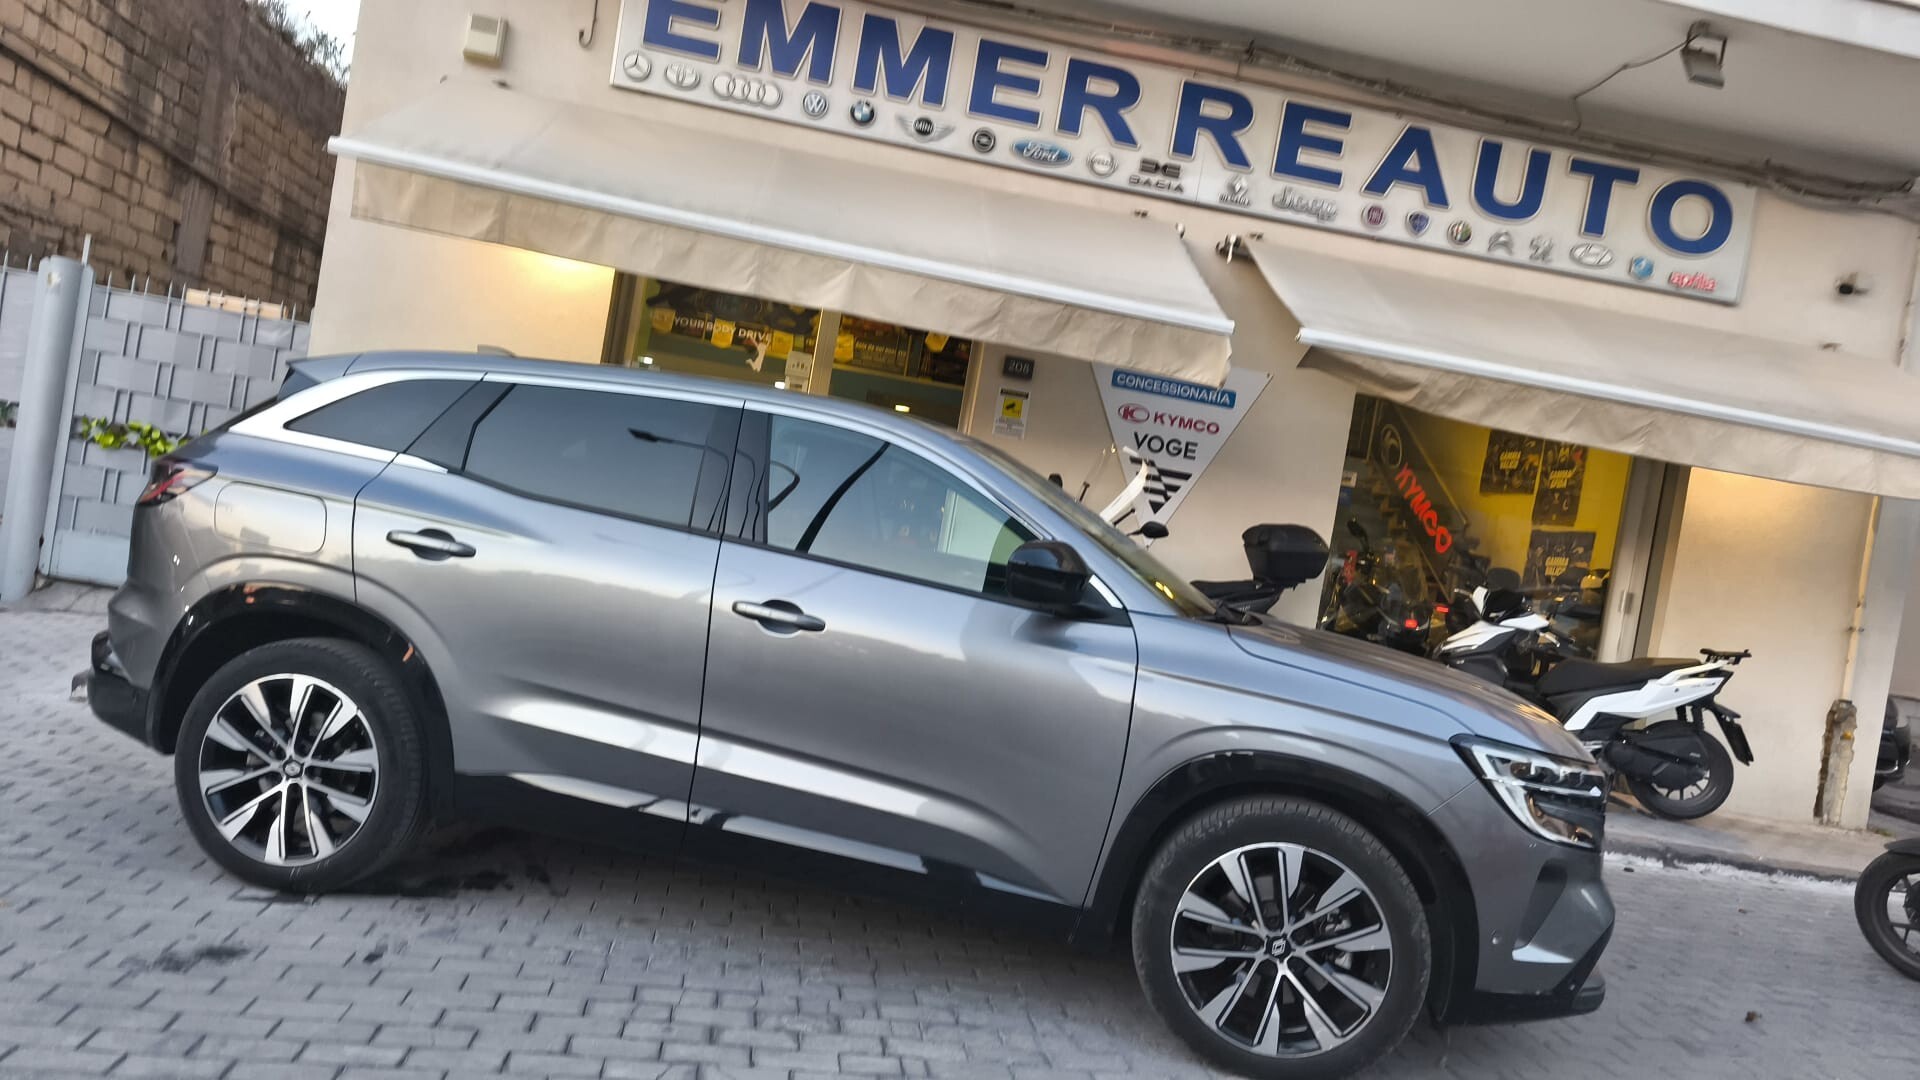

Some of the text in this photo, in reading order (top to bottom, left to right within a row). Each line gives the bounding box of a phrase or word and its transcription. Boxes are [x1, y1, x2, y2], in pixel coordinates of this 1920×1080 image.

[1022, 140, 1061, 163] Ford
[674, 315, 705, 330] YOUR
[707, 323, 736, 335] BODY
[1008, 359, 1029, 375] 208
[1116, 373, 1231, 405] CONCESSIONARIA
[1153, 412, 1220, 434] KYMCO
[1134, 431, 1198, 460] VOGE
[1396, 463, 1452, 553] KYMCO
